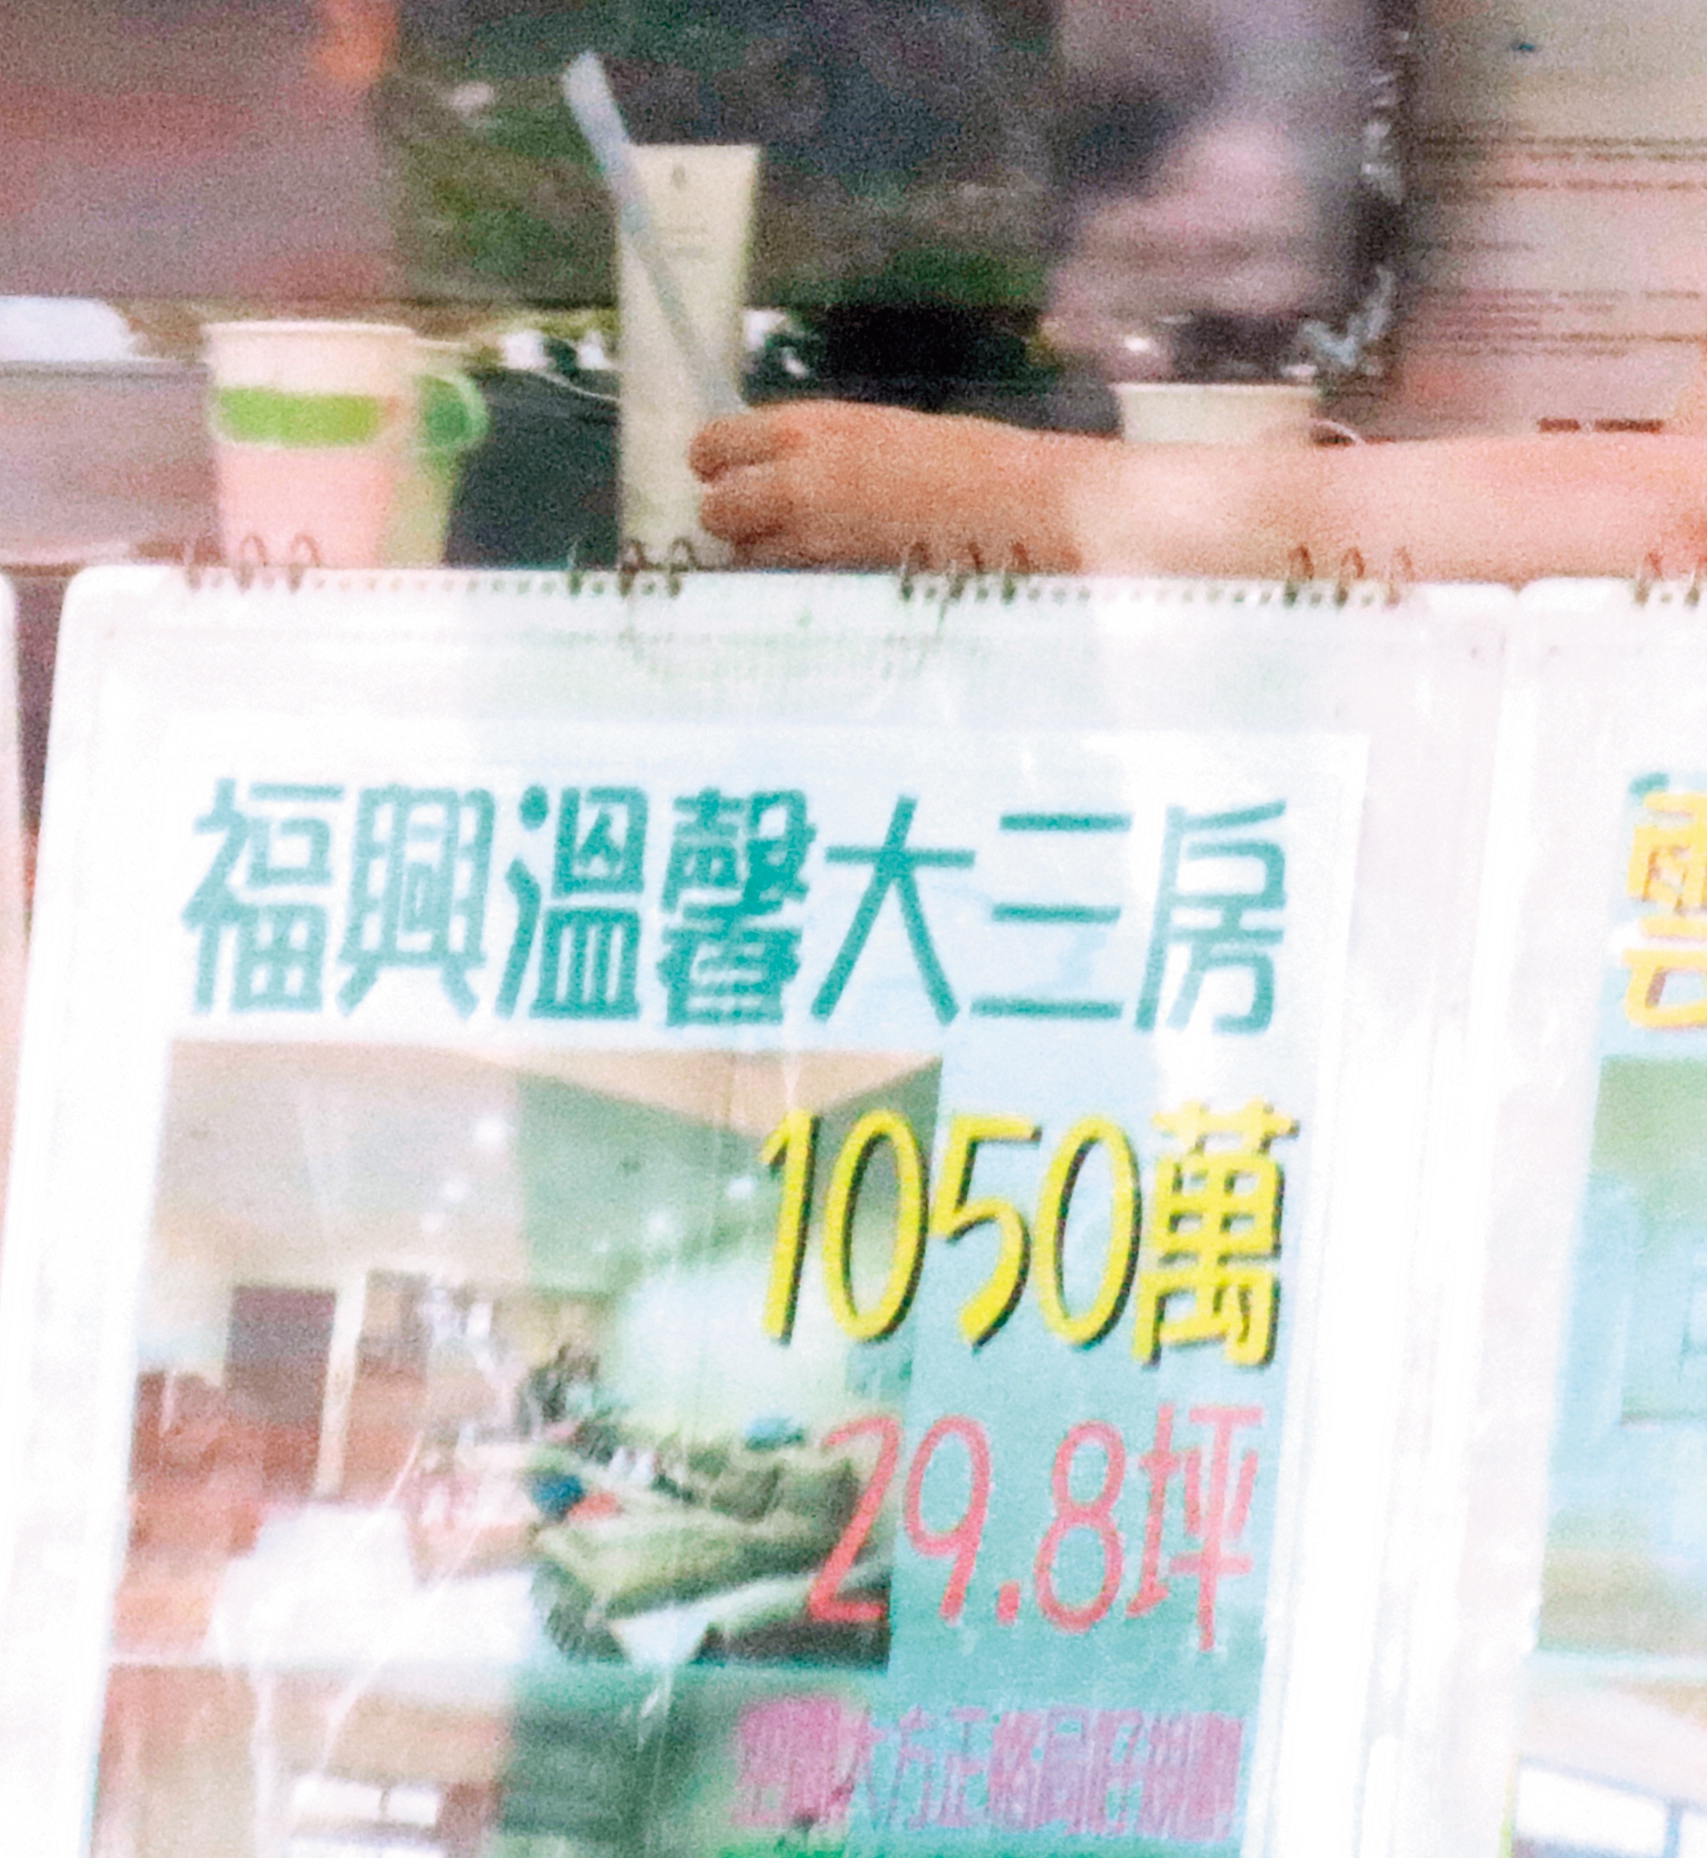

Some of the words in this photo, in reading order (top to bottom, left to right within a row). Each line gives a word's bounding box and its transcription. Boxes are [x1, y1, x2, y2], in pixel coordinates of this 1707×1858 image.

[183, 776, 1288, 1033] 福興溫馨大三房
[759, 1100, 1301, 1368] 1050萬
[801, 1401, 1264, 1651] 29.8坪
